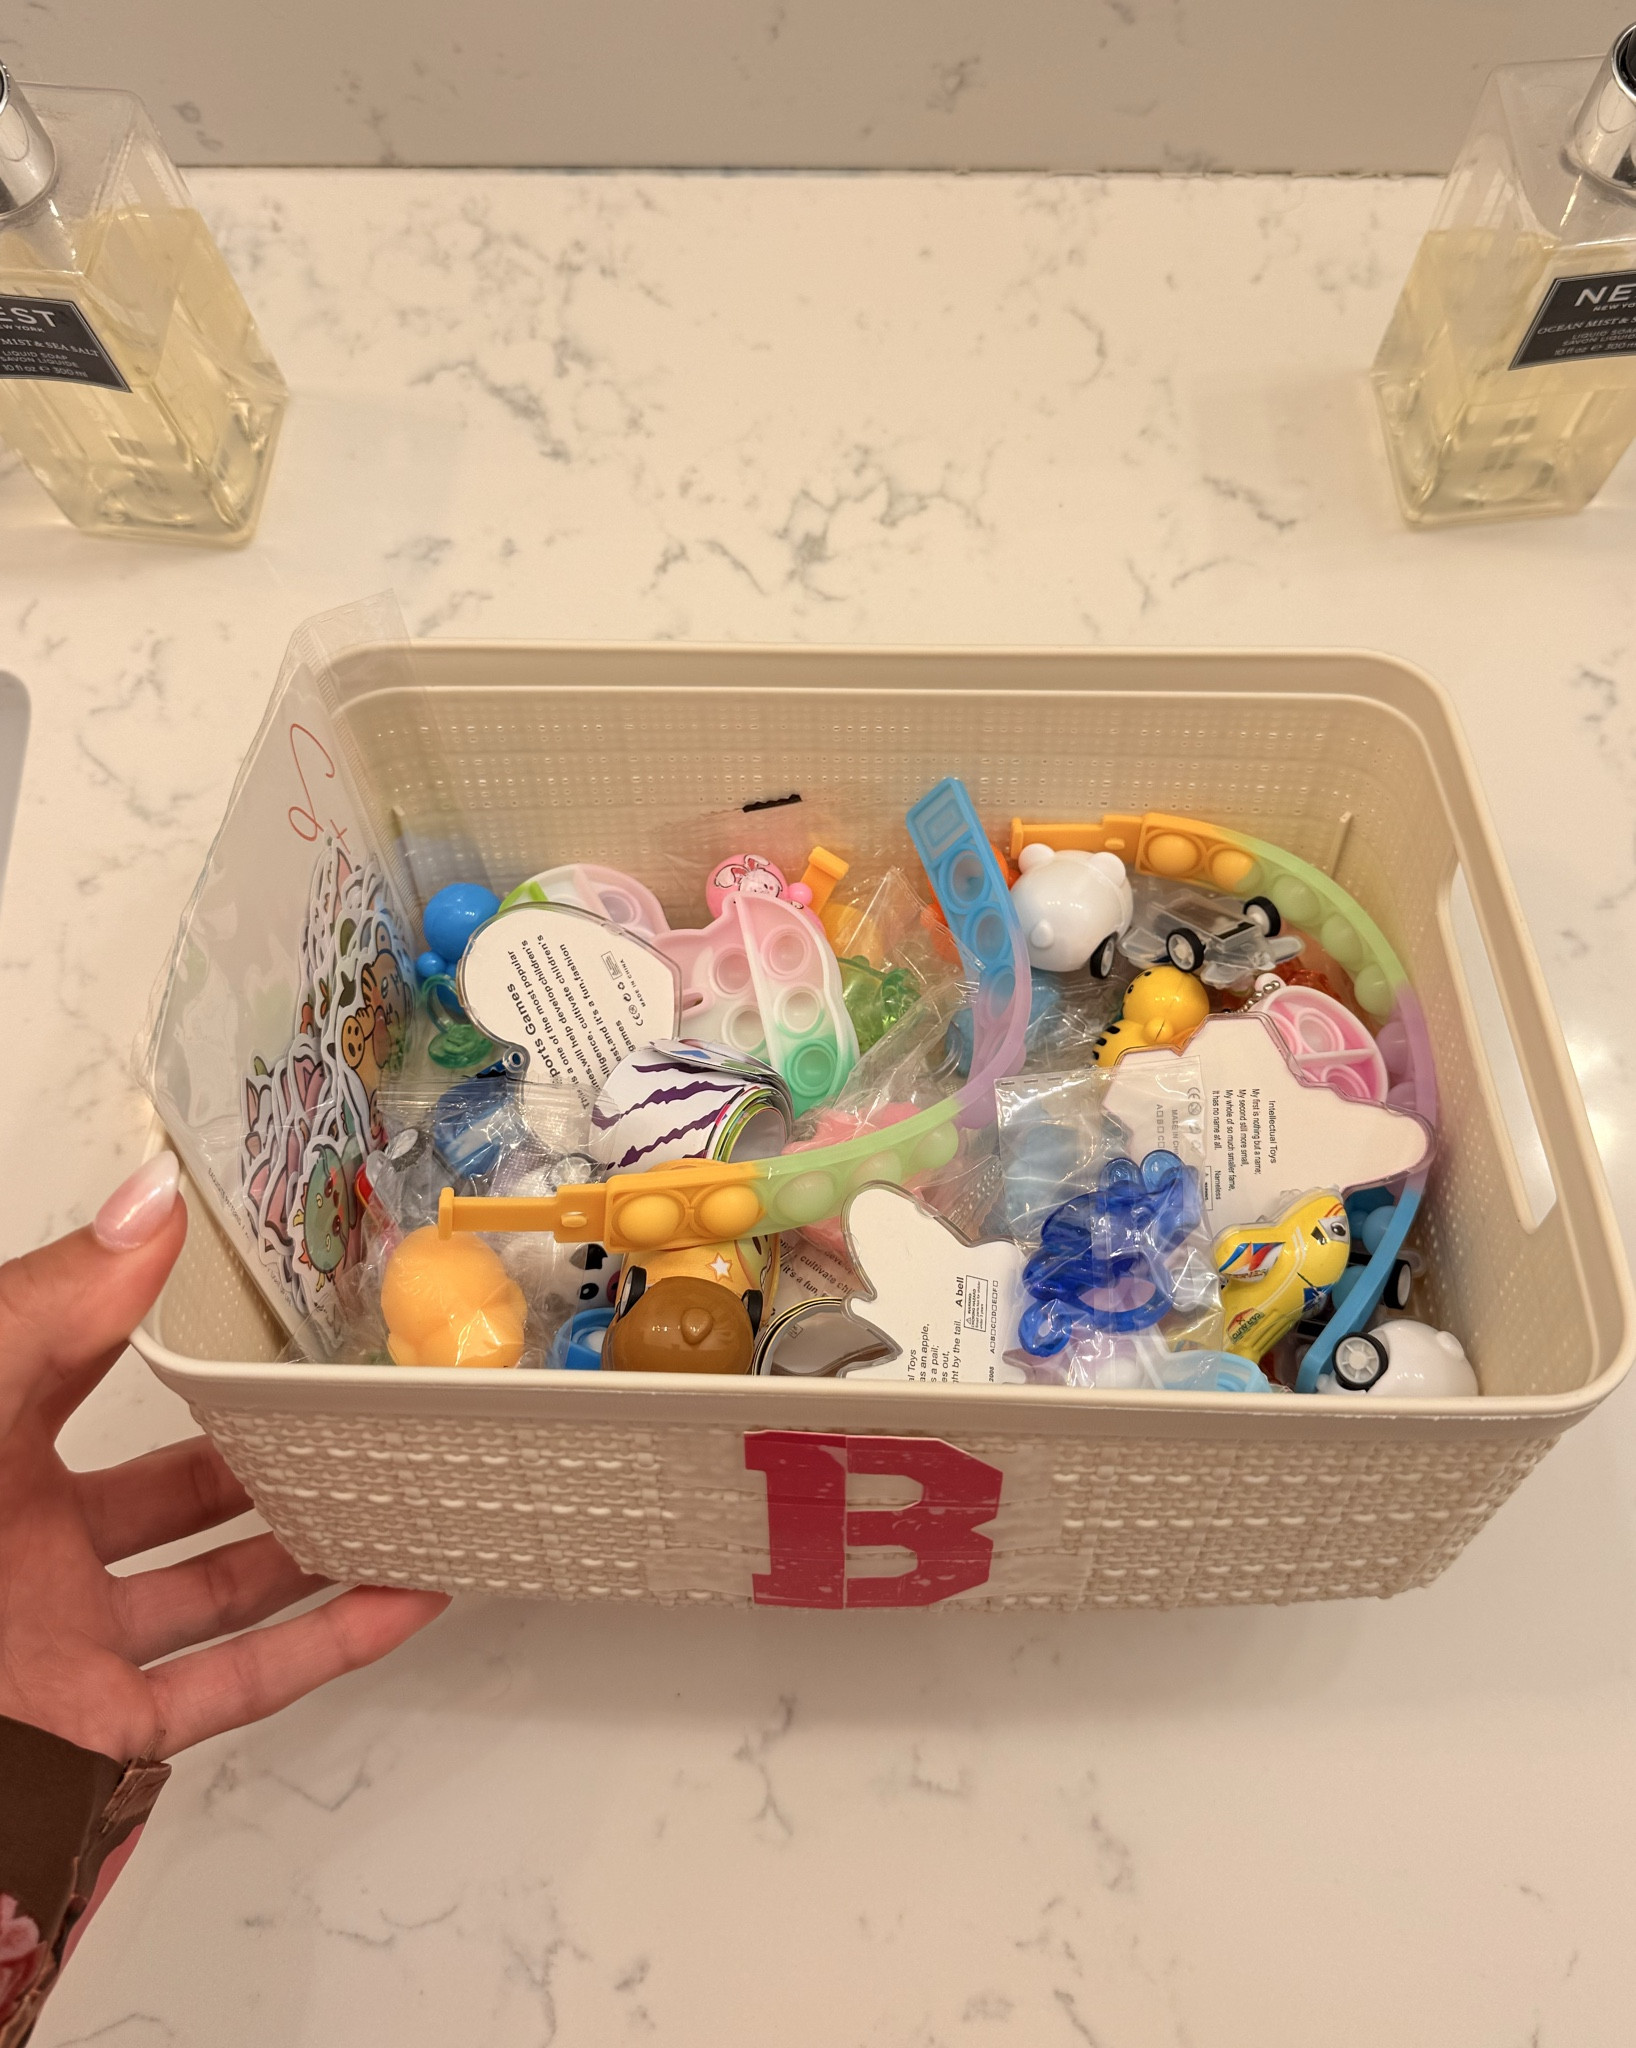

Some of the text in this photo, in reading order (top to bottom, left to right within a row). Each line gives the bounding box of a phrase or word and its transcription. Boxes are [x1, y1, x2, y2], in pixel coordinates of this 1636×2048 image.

[1574, 283, 1636, 307] NE
[1593, 304, 1620, 312] NEW
[14, 325, 45, 333] YORK
[1537, 322, 1585, 335] OCEAN
[1585, 318, 1620, 328] MIST
[1562, 338, 1598, 347] SAVON
[1572, 331, 1608, 341] LIQUID
[1, 338, 32, 347] MIST
[45, 342, 70, 351] SEA
[70, 345, 99, 357] SALT
[2, 350, 68, 360] LIQUID SOAP
[38, 358, 80, 369] LIQUIDE
[52, 366, 75, 376] 300
[537, 935, 565, 984] children's
[508, 950, 532, 988] popular
[620, 959, 632, 979] CHINA
[527, 989, 544, 1015] most
[635, 990, 646, 1007] MADE
[507, 984, 536, 1035] Games
[563, 987, 588, 1029] cultivate
[542, 1017, 553, 1033] the
[593, 1009, 603, 1025] it's
[549, 1035, 559, 1045] of
[565, 1026, 579, 1048] help
[616, 1020, 636, 1052] games
[557, 1047, 569, 1065] one
[571, 1076, 579, 1085] is
[1224, 1090, 1233, 1098] My
[1237, 1089, 1246, 1098] My
[1250, 1089, 1260, 1097] My
[1226, 1100, 1234, 1117] whole
[1238, 1100, 1247, 1120] second
[1252, 1118, 1262, 1139] nothing
[1268, 1100, 1277, 1163] Intellectual Toys
[1214, 1142, 1222, 1150] all.
[1227, 1135, 1235, 1151] much
[1254, 1141, 1262, 1149] but
[1228, 1152, 1236, 1173] smaller
[783, 1265, 796, 1277] it's
[800, 1256, 836, 1284] cultivate
[956, 1277, 964, 1296] bell
[955, 1299, 963, 1307] A
[921, 1324, 929, 1353] apple,
[908, 1349, 917, 1371] Toys
[920, 1356, 927, 1368] an
[931, 1344, 939, 1365] pail;
[942, 1351, 950, 1368] out,
[952, 1356, 961, 1368] by
[744, 1429, 1003, 1609] B
